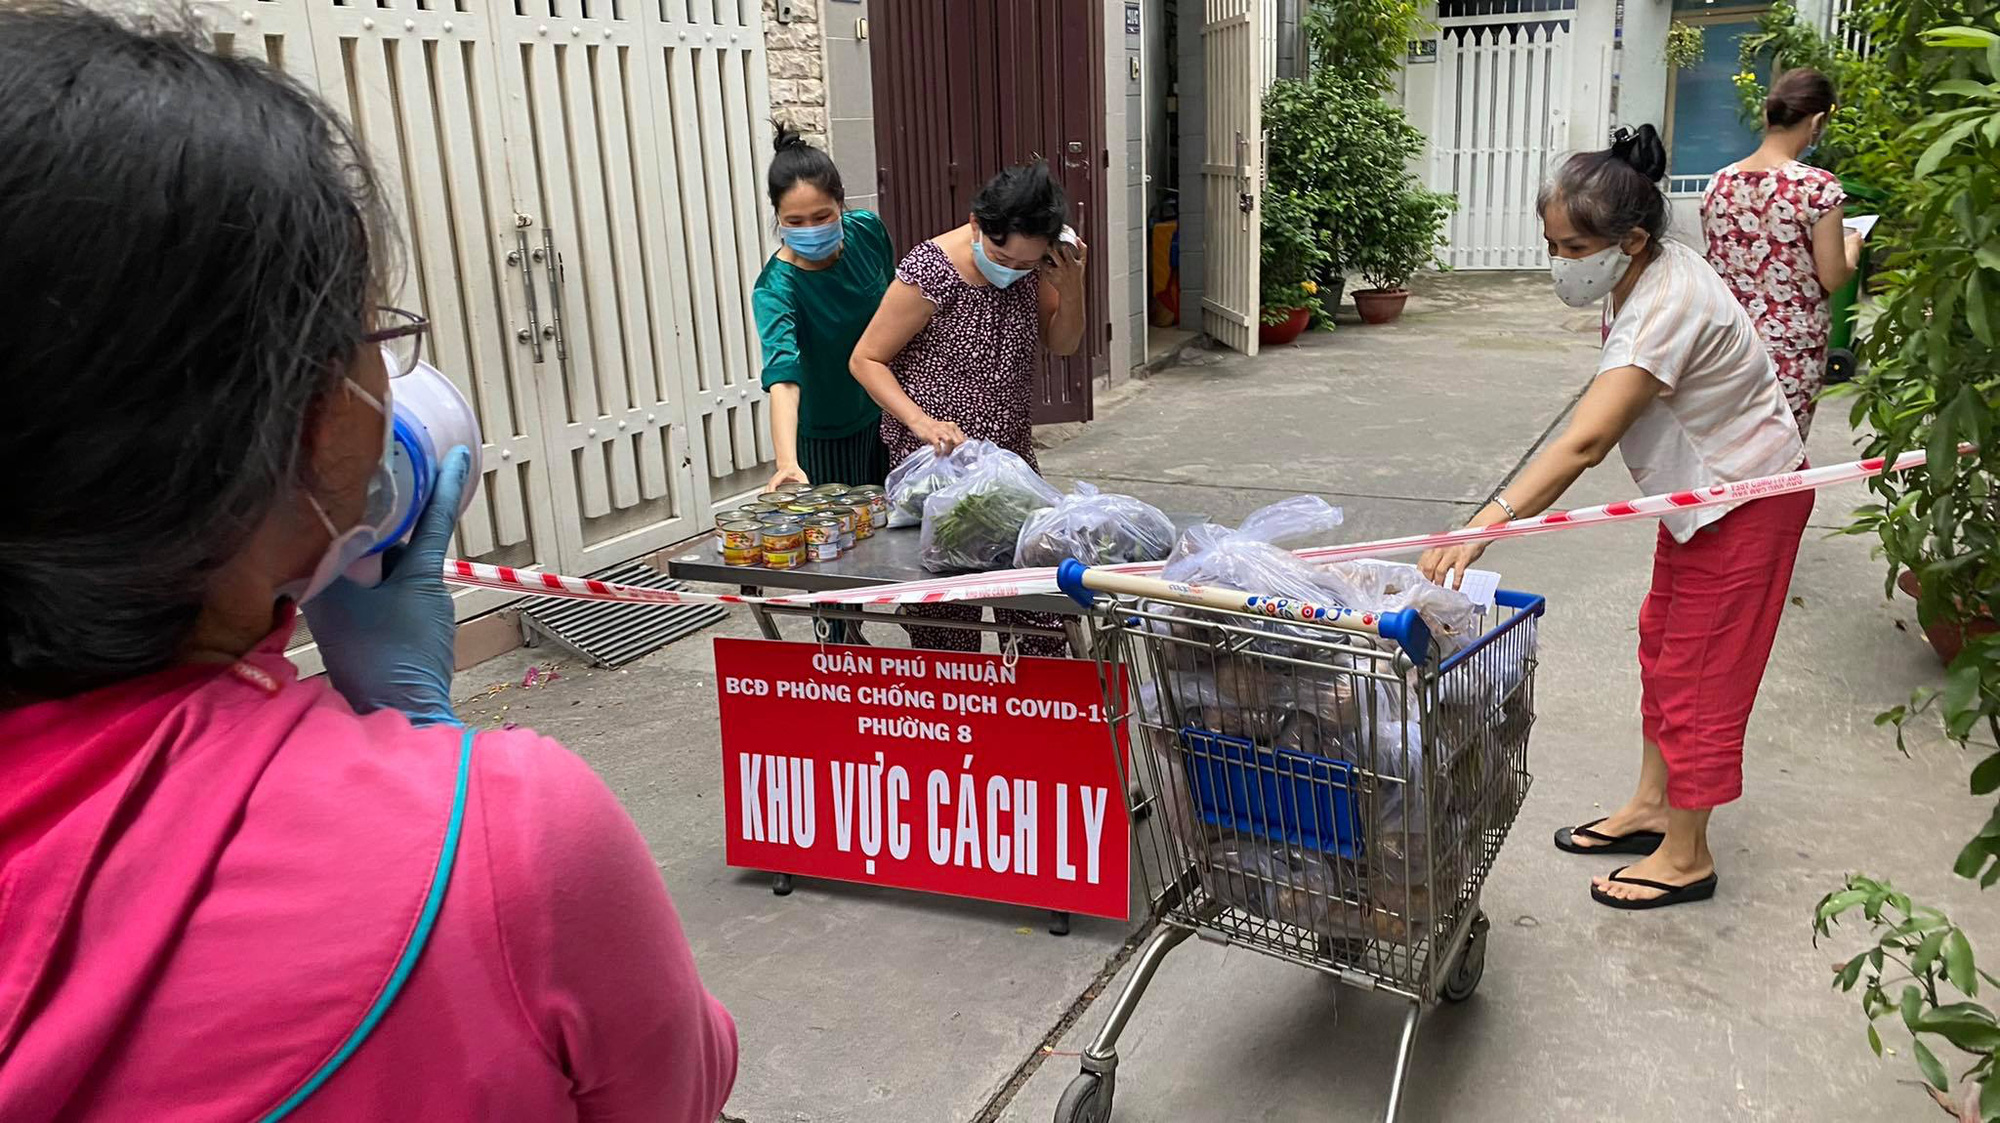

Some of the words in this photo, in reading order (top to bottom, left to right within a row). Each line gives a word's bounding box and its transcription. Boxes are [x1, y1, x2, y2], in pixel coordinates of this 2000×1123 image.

[812, 651, 873, 677] QUẬN
[880, 655, 926, 678] PHÚ
[935, 660, 1016, 686] NHUẬN
[725, 677, 769, 696] BCĐ
[776, 678, 851, 703] PHÒNG
[857, 683, 935, 709] CHỐNG
[942, 692, 997, 716] DỊCH
[858, 716, 951, 742] PHƯỜNG
[957, 724, 973, 743] 8
[739, 752, 816, 849] KHU
[830, 751, 911, 875] VỰC
[926, 754, 1038, 876] CÁCH
[1056, 782, 1108, 885] LY
